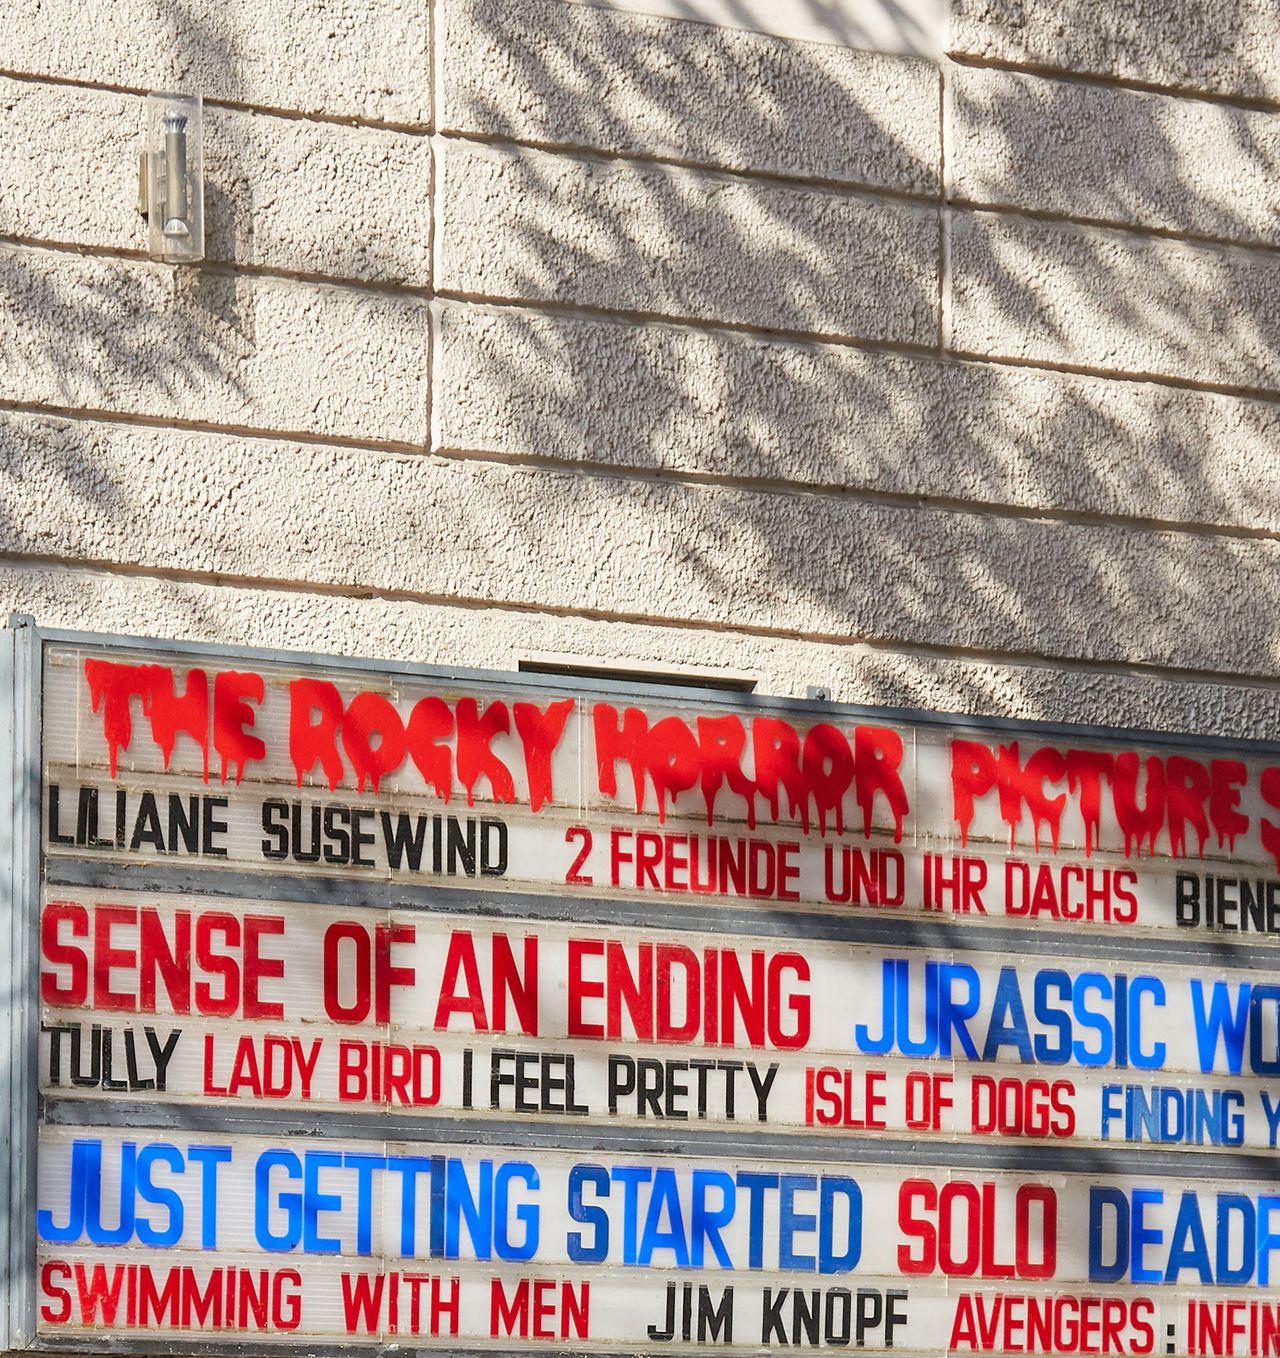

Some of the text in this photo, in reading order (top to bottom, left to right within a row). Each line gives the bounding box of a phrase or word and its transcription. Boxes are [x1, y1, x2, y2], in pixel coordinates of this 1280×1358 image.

[84, 657, 266, 785] THE
[289, 677, 575, 813] ROCKY
[592, 702, 910, 844] HORROR
[951, 738, 1250, 860] PICTURE
[48, 784, 229, 856] LILIANE
[261, 797, 509, 878] SUSEWIND
[564, 826, 593, 886] 2
[610, 825, 801, 900] FREUNDE
[824, 843, 905, 907] UND
[923, 851, 988, 916] IHR
[1004, 860, 1139, 925] DACHS
[40, 900, 286, 1021] SENSE
[323, 920, 417, 1027] OF
[433, 930, 539, 1036] AN
[567, 938, 812, 1051] ENDING
[855, 958, 1167, 1072] JURASSIC
[40, 1021, 183, 1092] TULLY
[204, 1033, 324, 1100] LADY
[338, 1039, 442, 1107] BIRD
[463, 1047, 474, 1108] I
[490, 1047, 589, 1116] FEEL
[607, 1053, 781, 1122] PRETTY
[805, 1066, 888, 1131] ISLE
[904, 1070, 955, 1132] OF
[971, 1075, 1077, 1138] DOGS
[1101, 1083, 1245, 1148] FINDING
[37, 1138, 233, 1252] JUST
[254, 1147, 541, 1263] GETTING
[566, 1162, 864, 1276] STARTED
[896, 1177, 1058, 1281] SOLO
[40, 1259, 302, 1331] SWIMMING
[340, 1271, 461, 1338] WITH
[489, 1277, 592, 1342] MEN
[646, 1280, 735, 1347] JIM
[761, 1285, 910, 1349] KNOPF
